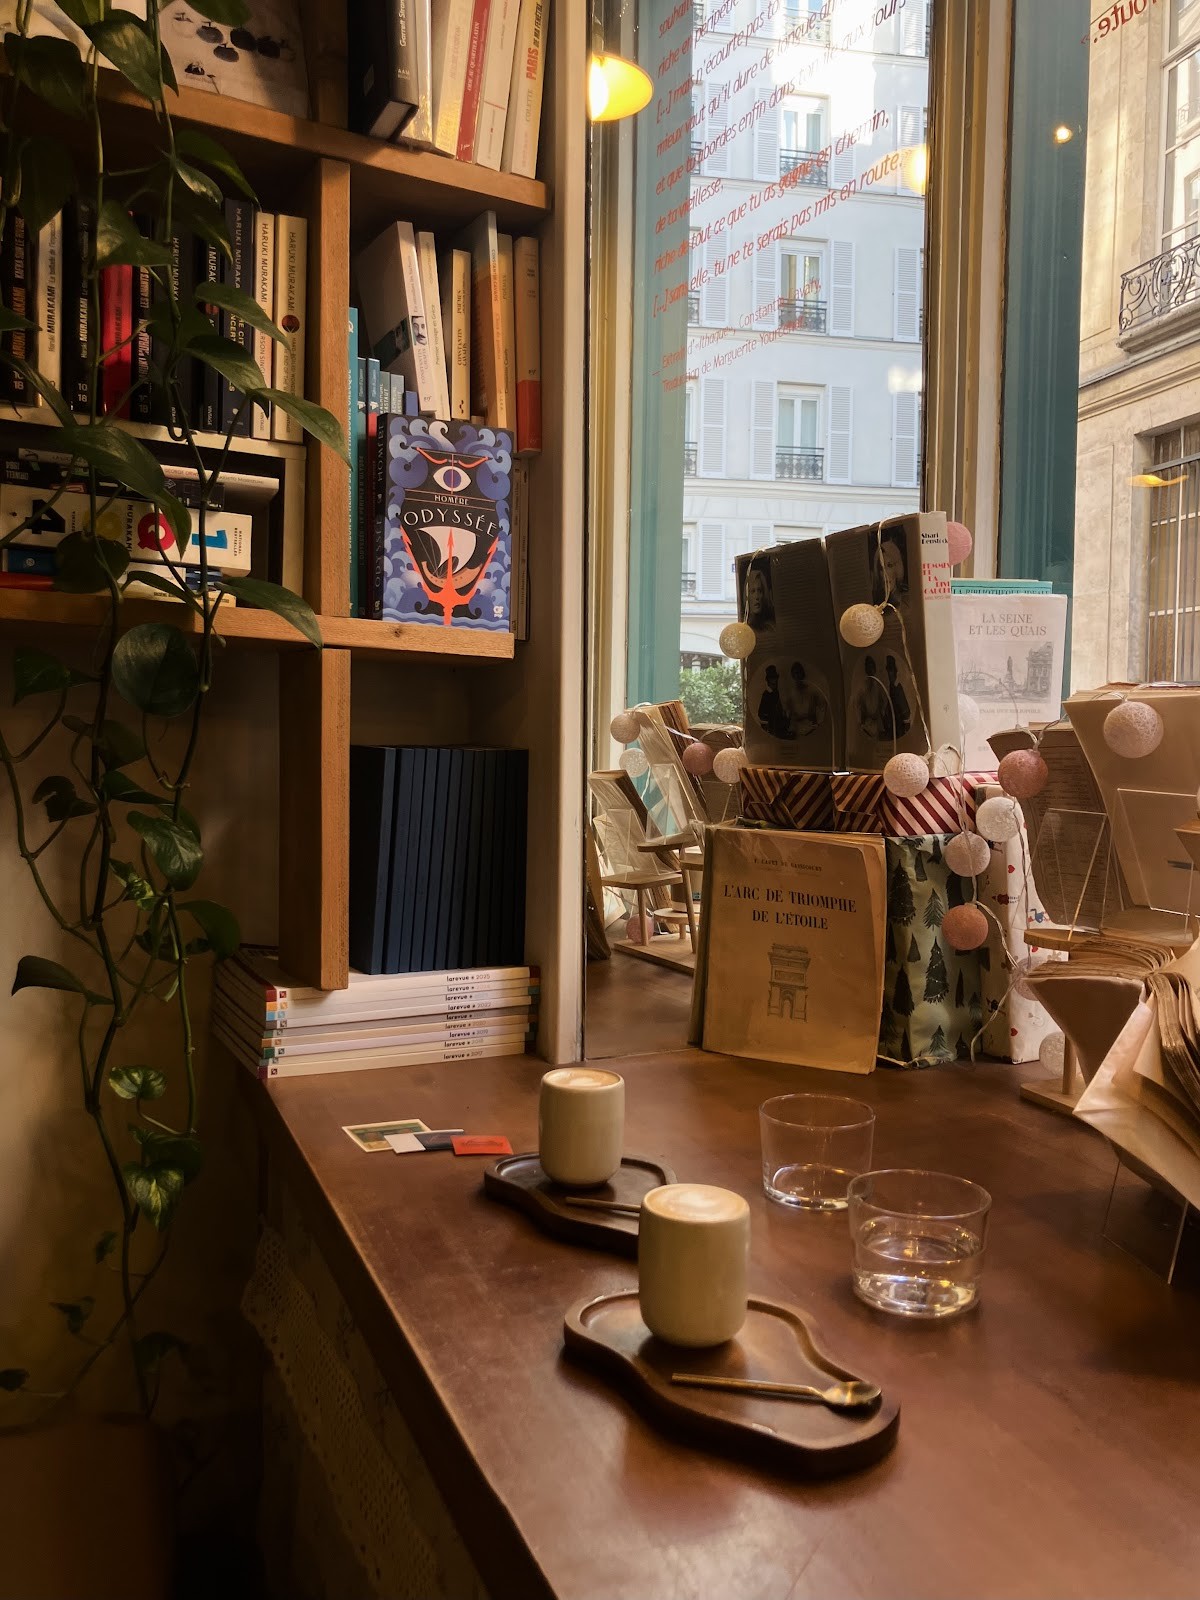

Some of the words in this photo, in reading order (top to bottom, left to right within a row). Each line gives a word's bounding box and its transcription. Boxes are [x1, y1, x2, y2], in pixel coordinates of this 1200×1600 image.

[472, 21, 481, 39] LATIN
[745, 12, 765, 47] pas
[469, 40, 477, 69] QUARTIER
[525, 47, 539, 81] PARIS
[733, 62, 758, 94] dure
[760, 47, 774, 71] de
[698, 124, 737, 163] abordes
[738, 100, 766, 129] enfin
[769, 78, 796, 109] dans
[691, 222, 712, 250] tout
[714, 216, 726, 235] ce
[727, 202, 748, 231] que
[749, 192, 762, 212] tu
[764, 182, 777, 203] as
[816, 145, 832, 168] en
[261, 223, 269, 255] HARUKI
[288, 232, 296, 262] HARUKI
[690, 267, 711, 292] elle,
[714, 258, 725, 278] tu
[727, 250, 740, 270] ne
[742, 241, 755, 260] te
[756, 217, 789, 252] serais
[790, 205, 812, 237] pas
[814, 188, 837, 217] mis
[840, 178, 857, 201] en
[287, 265, 296, 312] MURAKAMI
[46, 286, 56, 334] MURAKAMI
[79, 298, 88, 342] MURAKAMI
[432, 327, 440, 345] voyage
[433, 346, 441, 365] Premier
[702, 359, 712, 375] de
[713, 335, 757, 368] Marguerite
[13, 381, 24, 390] 18
[78, 383, 88, 391] 10
[78, 394, 88, 403] 18
[25, 499, 66, 535] 4
[404, 508, 498, 537] ODYSSÉE
[969, 625, 983, 636] ET
[986, 625, 1006, 636] LES
[1010, 625, 1047, 637] QUAIS
[982, 613, 995, 624] LA
[999, 613, 1033, 624] SEINE
[724, 884, 760, 901] L'ARC
[766, 888, 783, 903] DE
[788, 890, 857, 913] TRIOMPHE
[752, 909, 769, 923] DE
[775, 911, 829, 930] L'ÉTOILE
